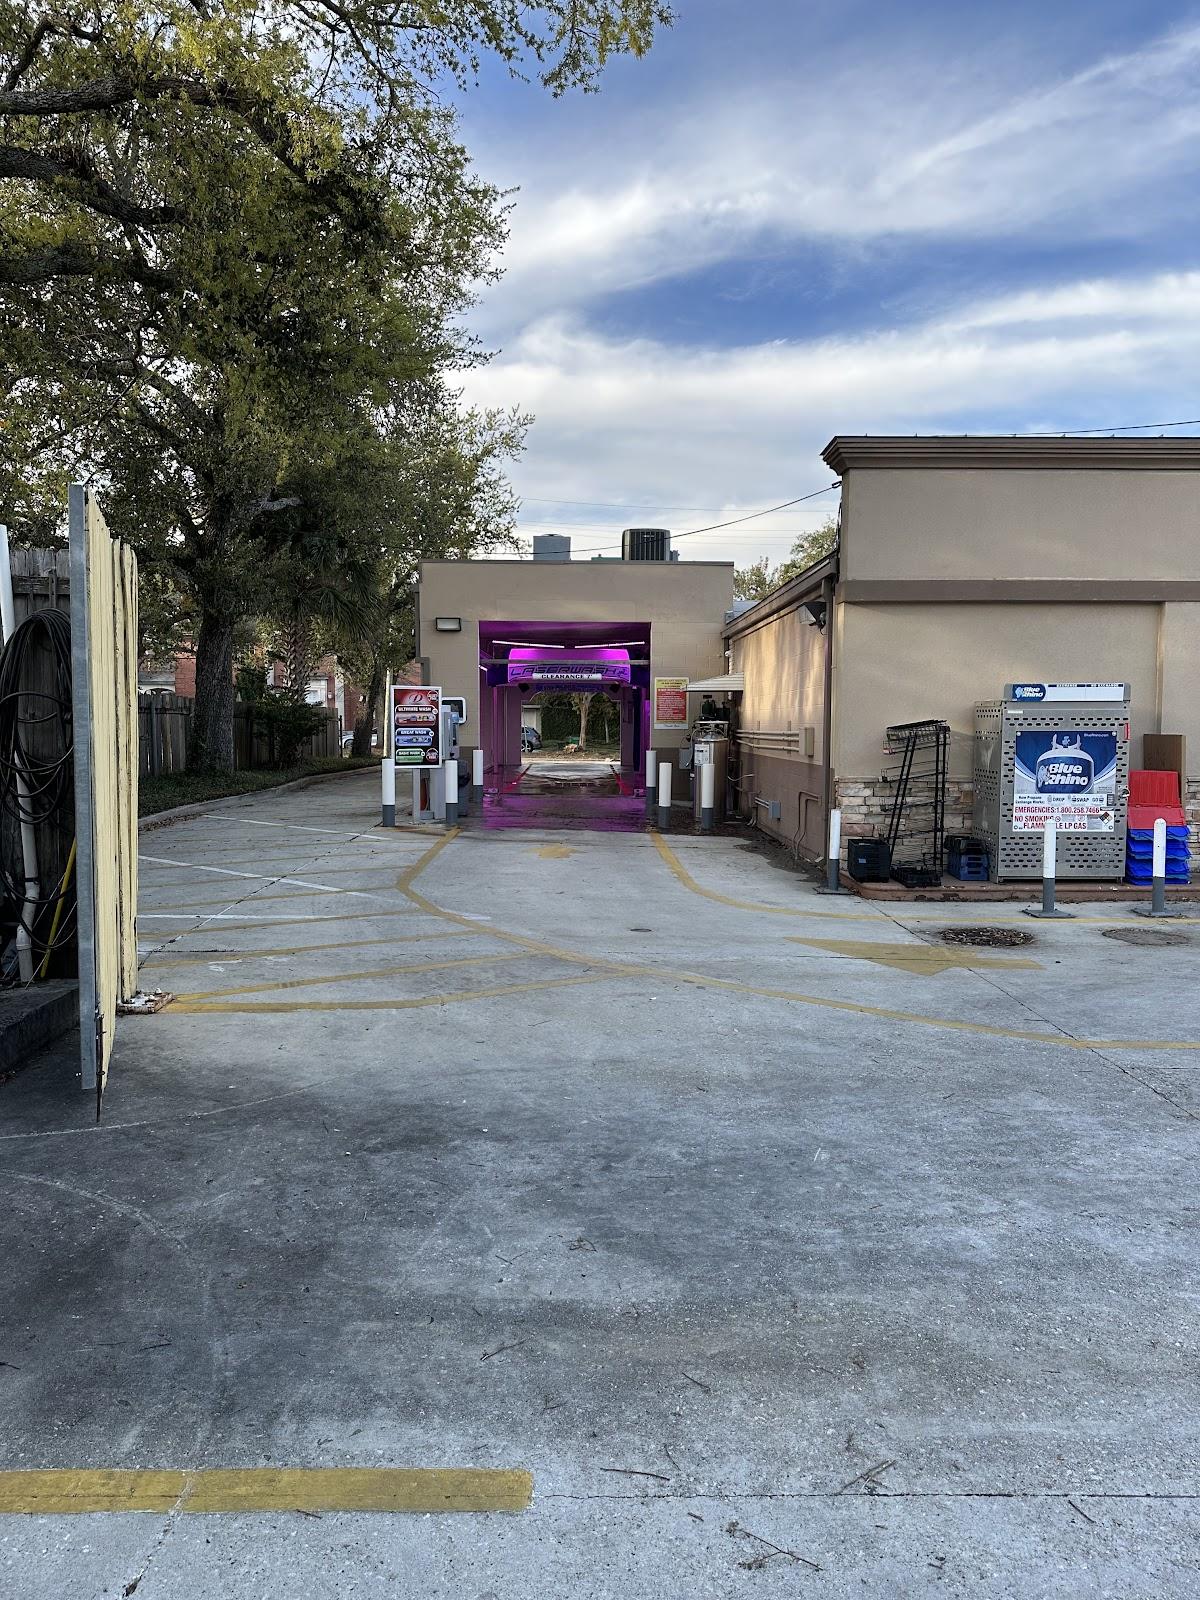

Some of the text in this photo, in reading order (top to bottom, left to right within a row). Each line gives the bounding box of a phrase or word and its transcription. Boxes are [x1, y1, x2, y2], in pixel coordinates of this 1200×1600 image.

[1048, 763, 1083, 774] Blue
[1044, 773, 1089, 786] Rhino
[1014, 815, 1024, 823] NO
[1023, 822, 1063, 830] FLAMMLE
[1064, 822, 1073, 830] LP
[1073, 822, 1087, 830] GAS
